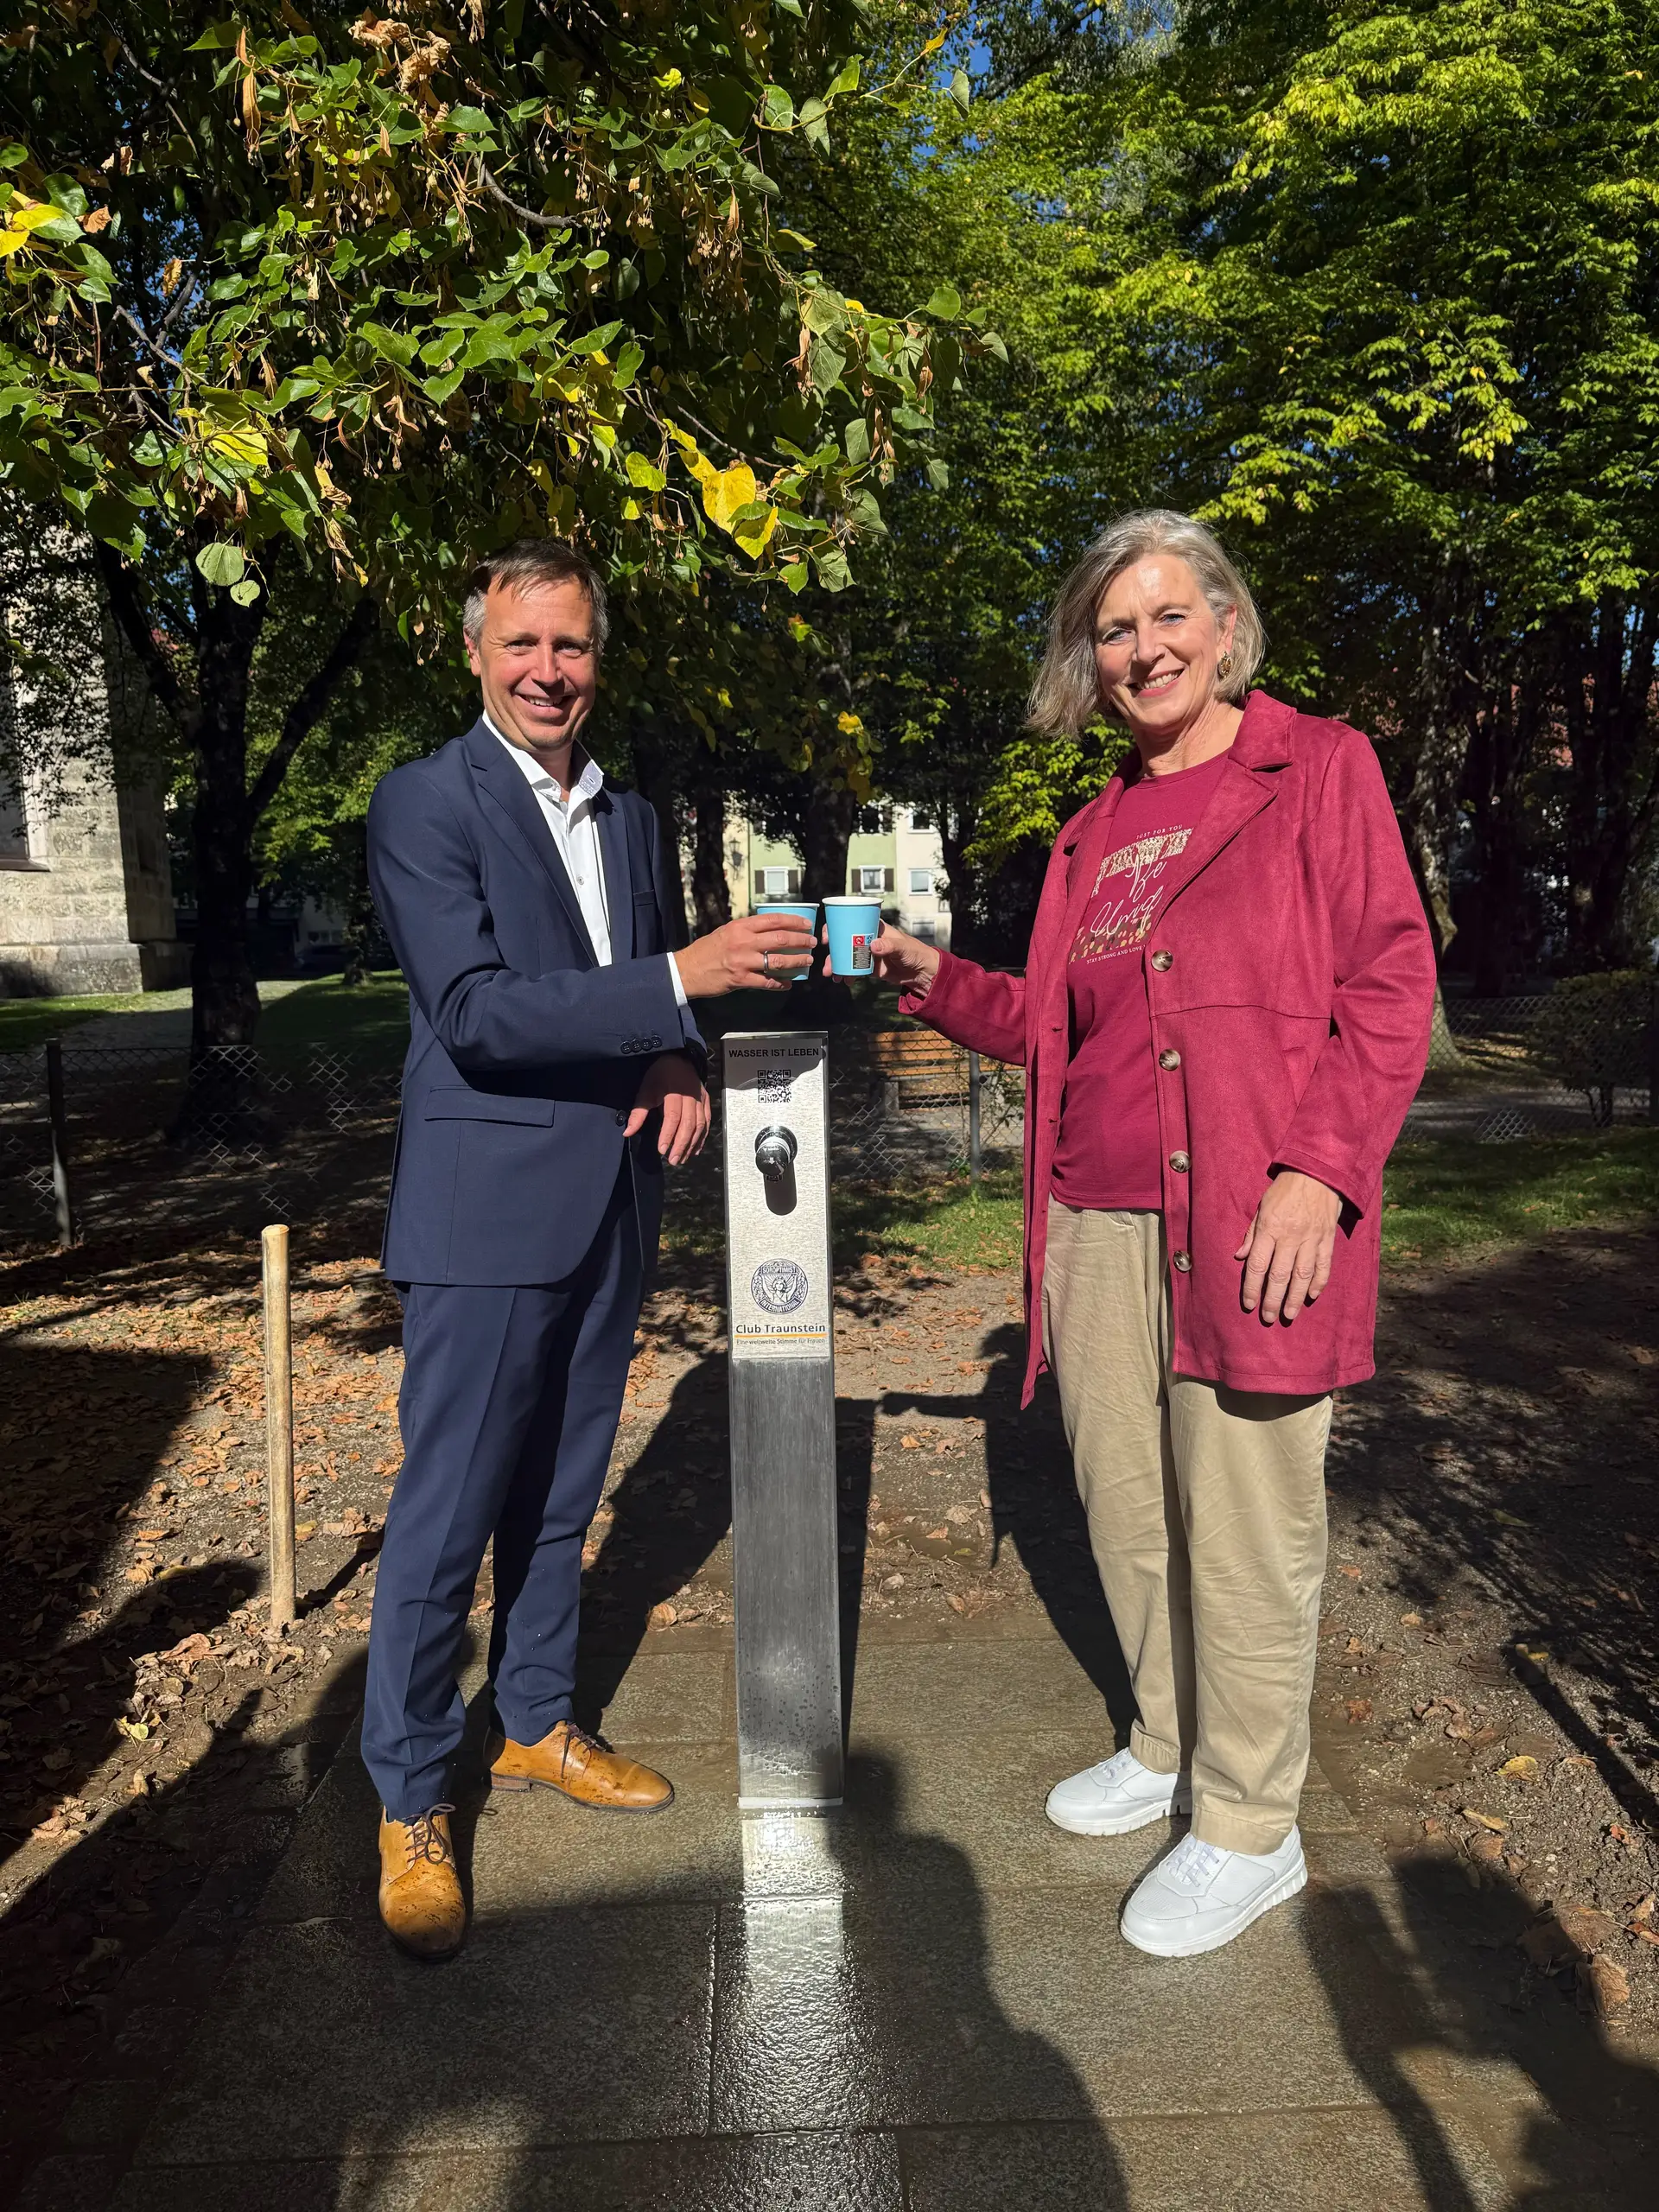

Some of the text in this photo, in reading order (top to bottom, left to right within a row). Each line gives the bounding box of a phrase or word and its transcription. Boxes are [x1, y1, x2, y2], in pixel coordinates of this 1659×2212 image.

[1136, 831, 1151, 840] JUST
[1124, 853, 1167, 903] Be
[1097, 951, 1116, 962] STRONG
[728, 1049, 769, 1058] WASSER
[788, 1048, 819, 1057] LEBEN
[760, 1297, 800, 1313] INTERNATIONAL
[735, 1323, 825, 1333] Club Traunstein
